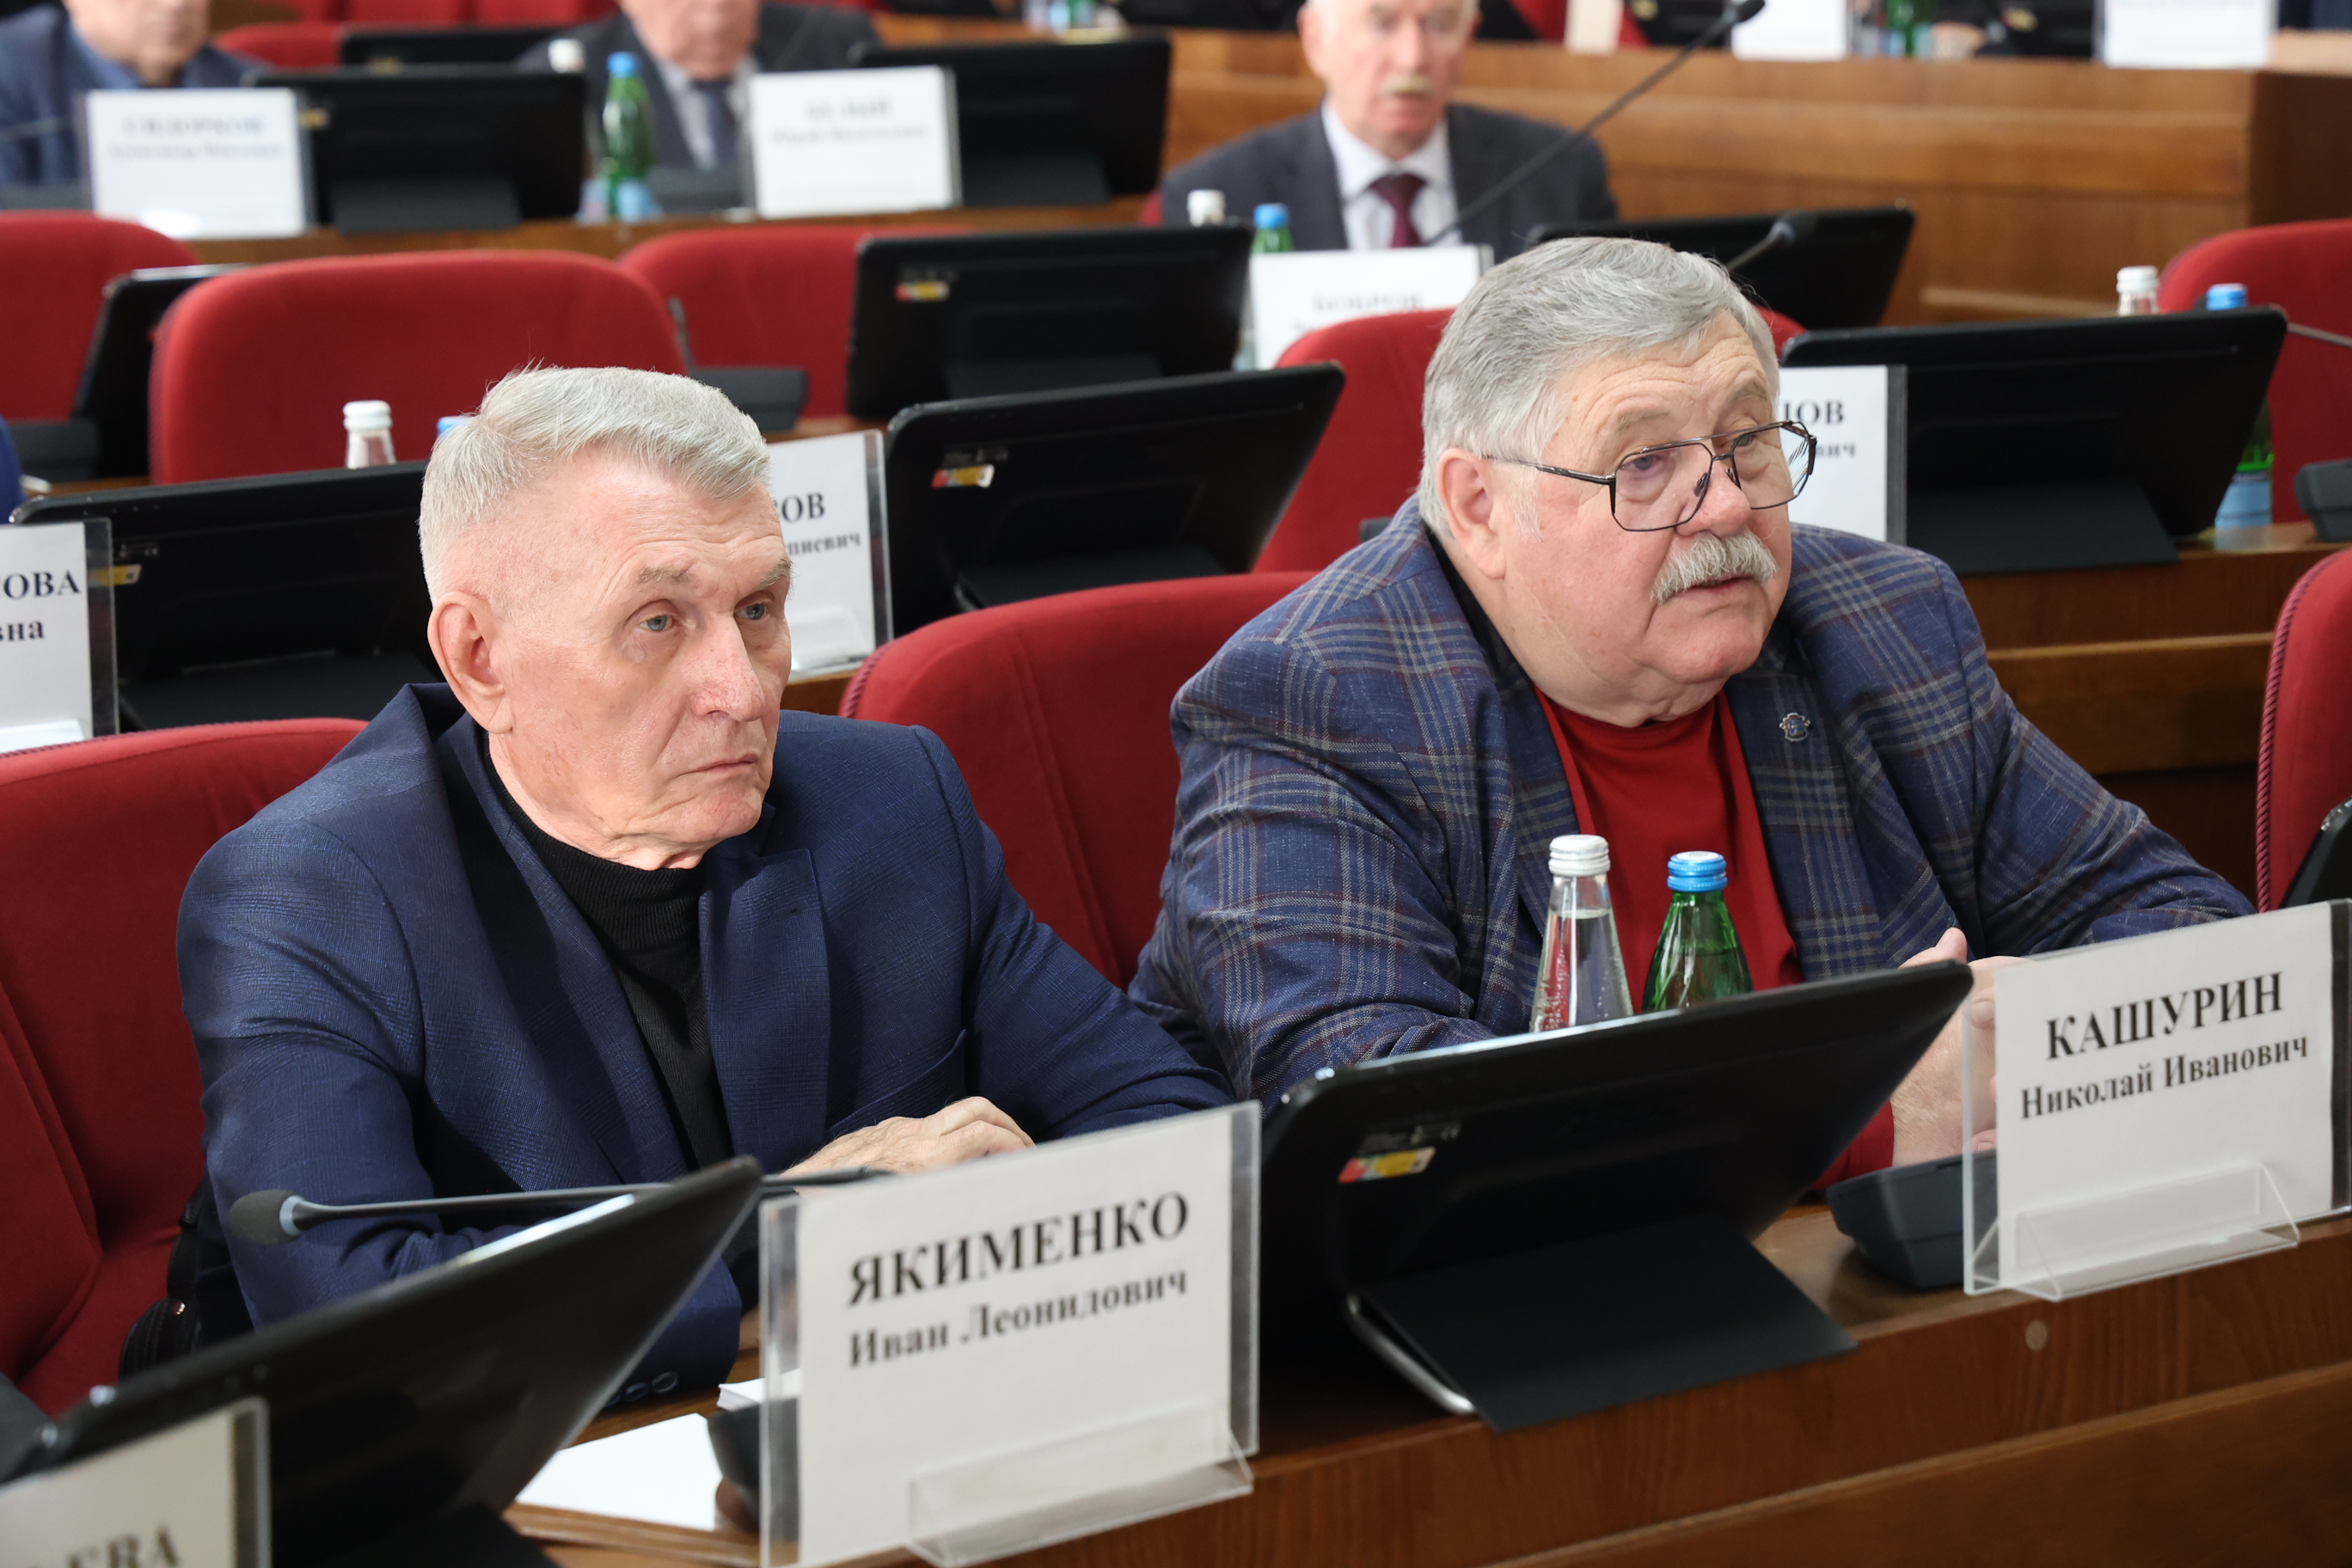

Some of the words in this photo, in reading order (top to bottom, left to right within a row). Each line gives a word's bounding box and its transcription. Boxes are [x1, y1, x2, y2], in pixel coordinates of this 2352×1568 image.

[773, 492, 825, 524] ОВ
[0, 569, 82, 600] ОВА
[2045, 971, 2283, 1060] КАШУРИН
[2020, 1063, 2154, 1119] Николай
[2163, 1036, 2309, 1090] Иванович
[847, 1191, 1191, 1308] ЯКИМЕНКО
[848, 1318, 948, 1369] Иван
[959, 1268, 1188, 1344] Леонидович
